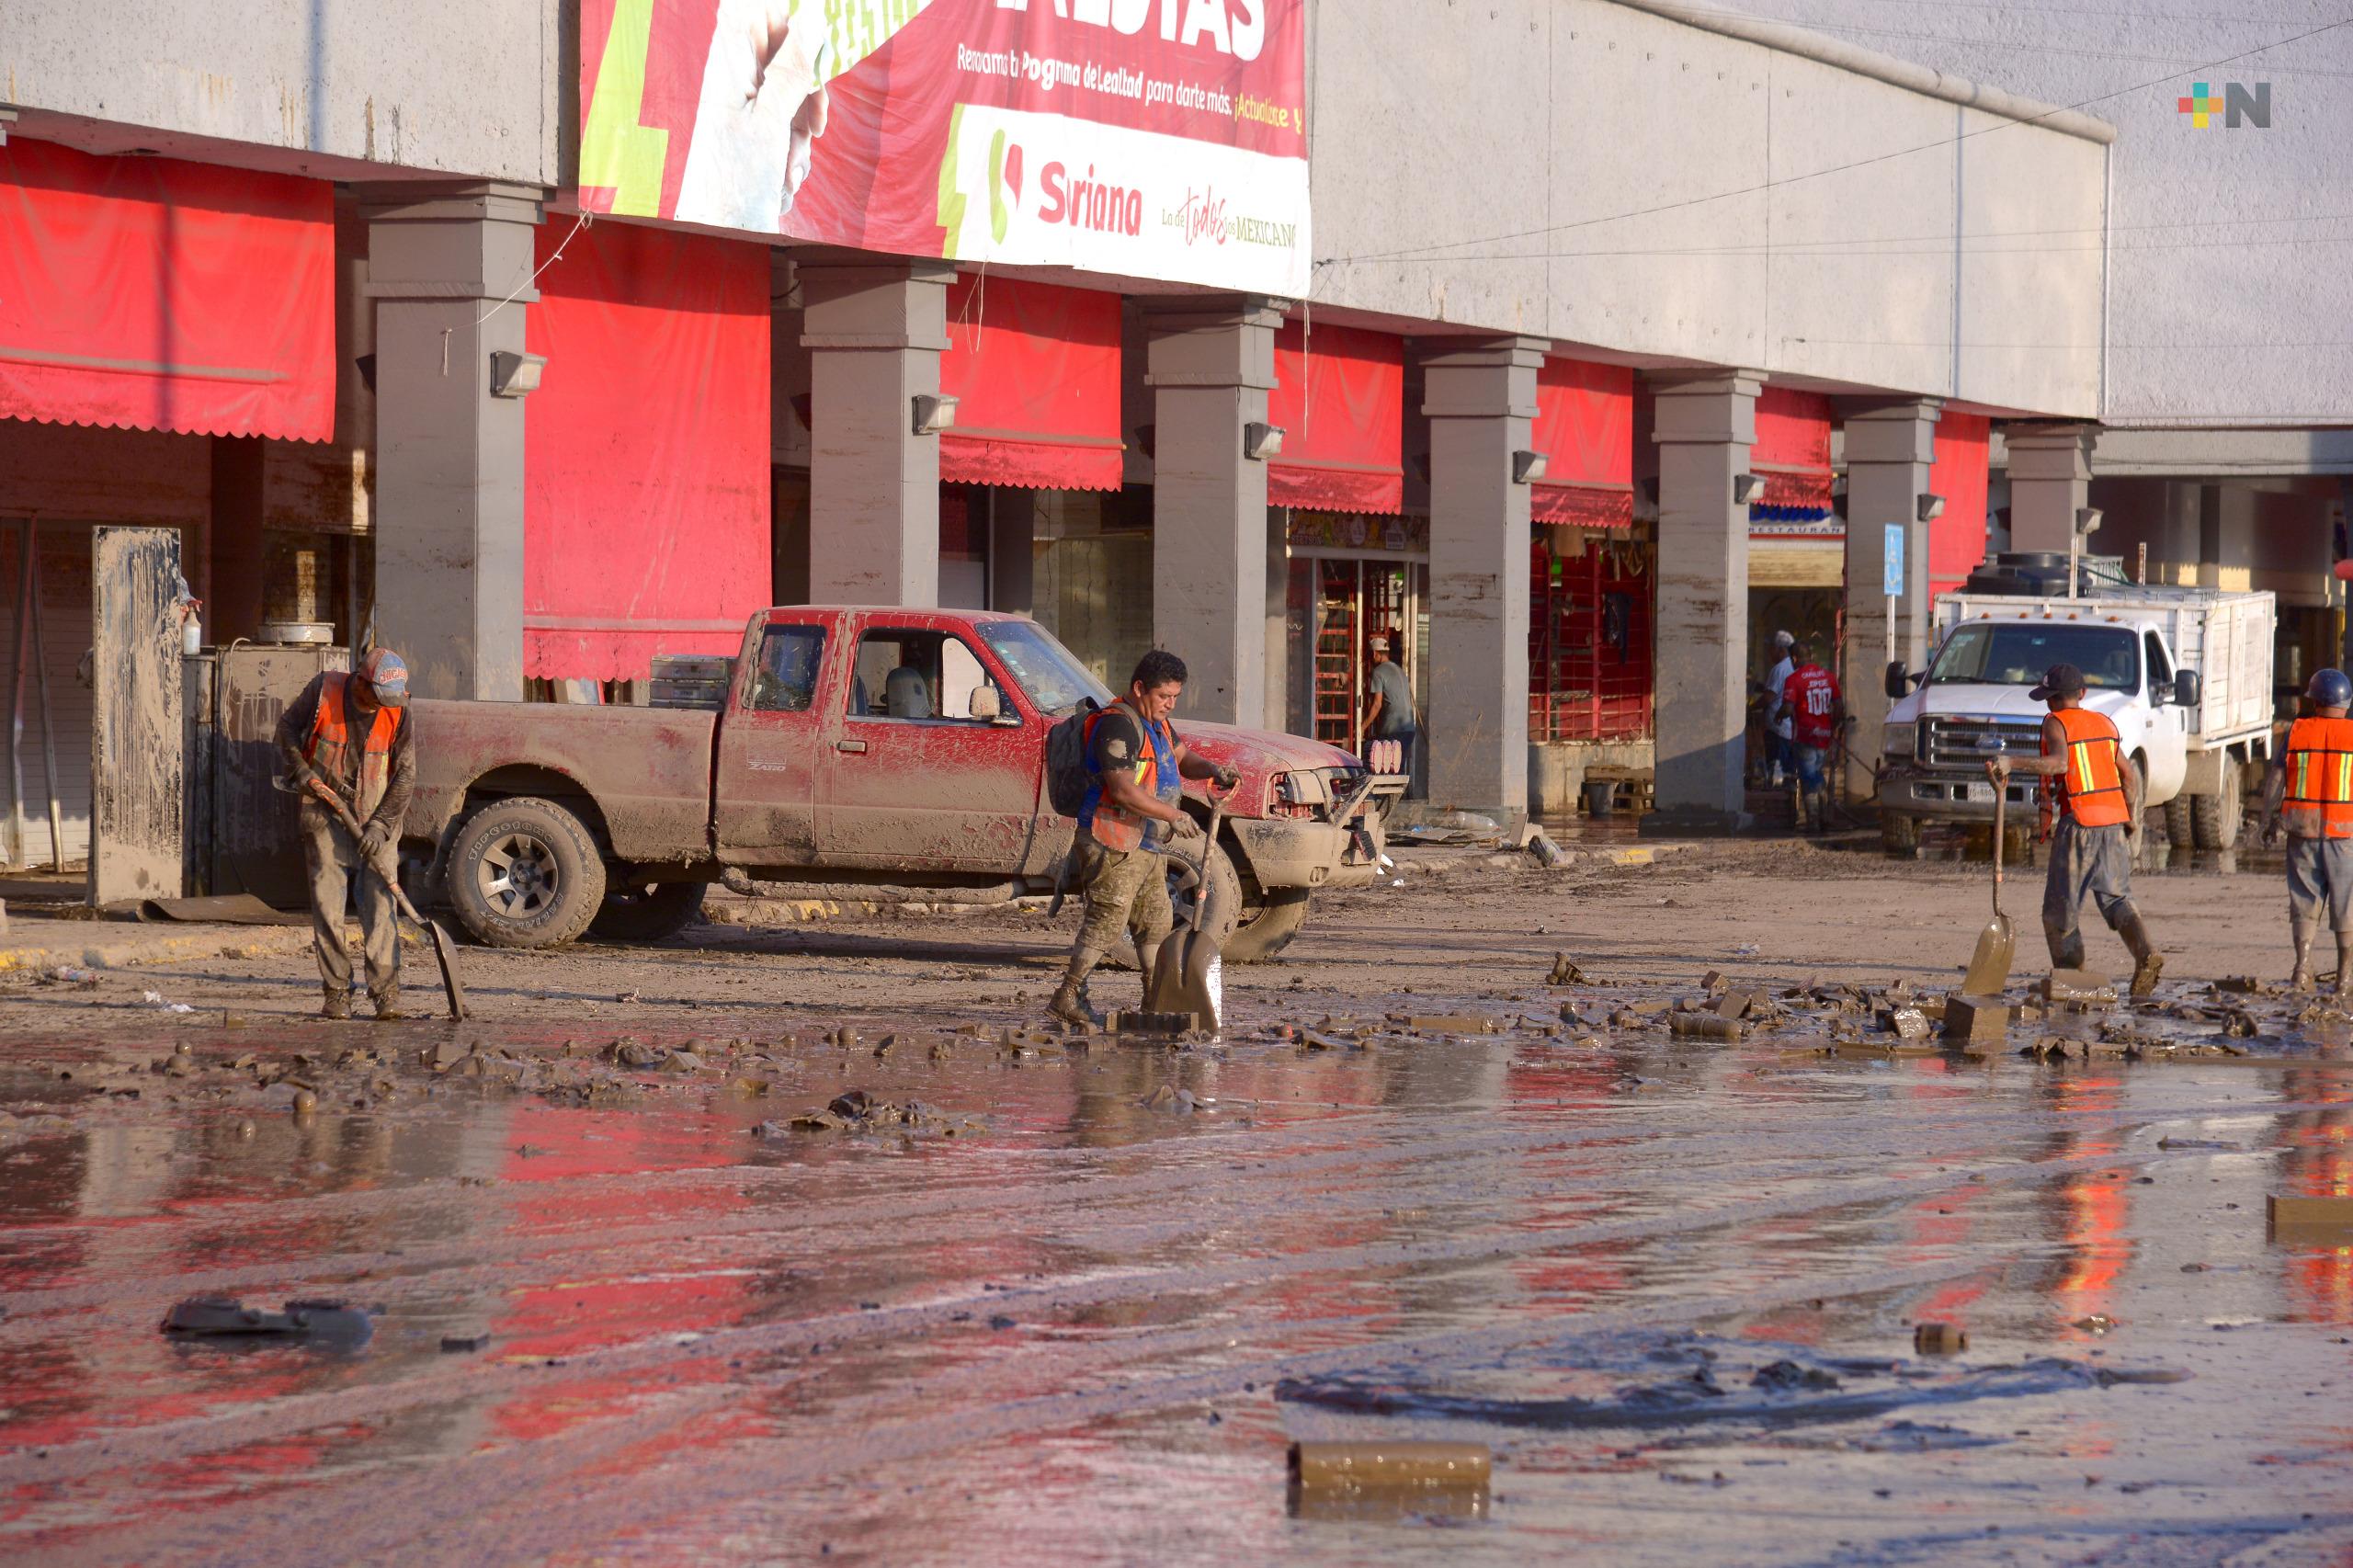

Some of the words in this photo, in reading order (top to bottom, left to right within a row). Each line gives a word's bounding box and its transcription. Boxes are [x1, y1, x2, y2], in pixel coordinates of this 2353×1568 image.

[1083, 60, 1097, 89] de
[1097, 64, 1143, 99] Lealtad
[1144, 79, 1174, 107] para
[1176, 78, 1206, 110] darte
[1207, 85, 1233, 116] más.
[1162, 208, 1173, 226] La
[1178, 185, 1226, 246] todos
[1806, 687, 1832, 716] 100
